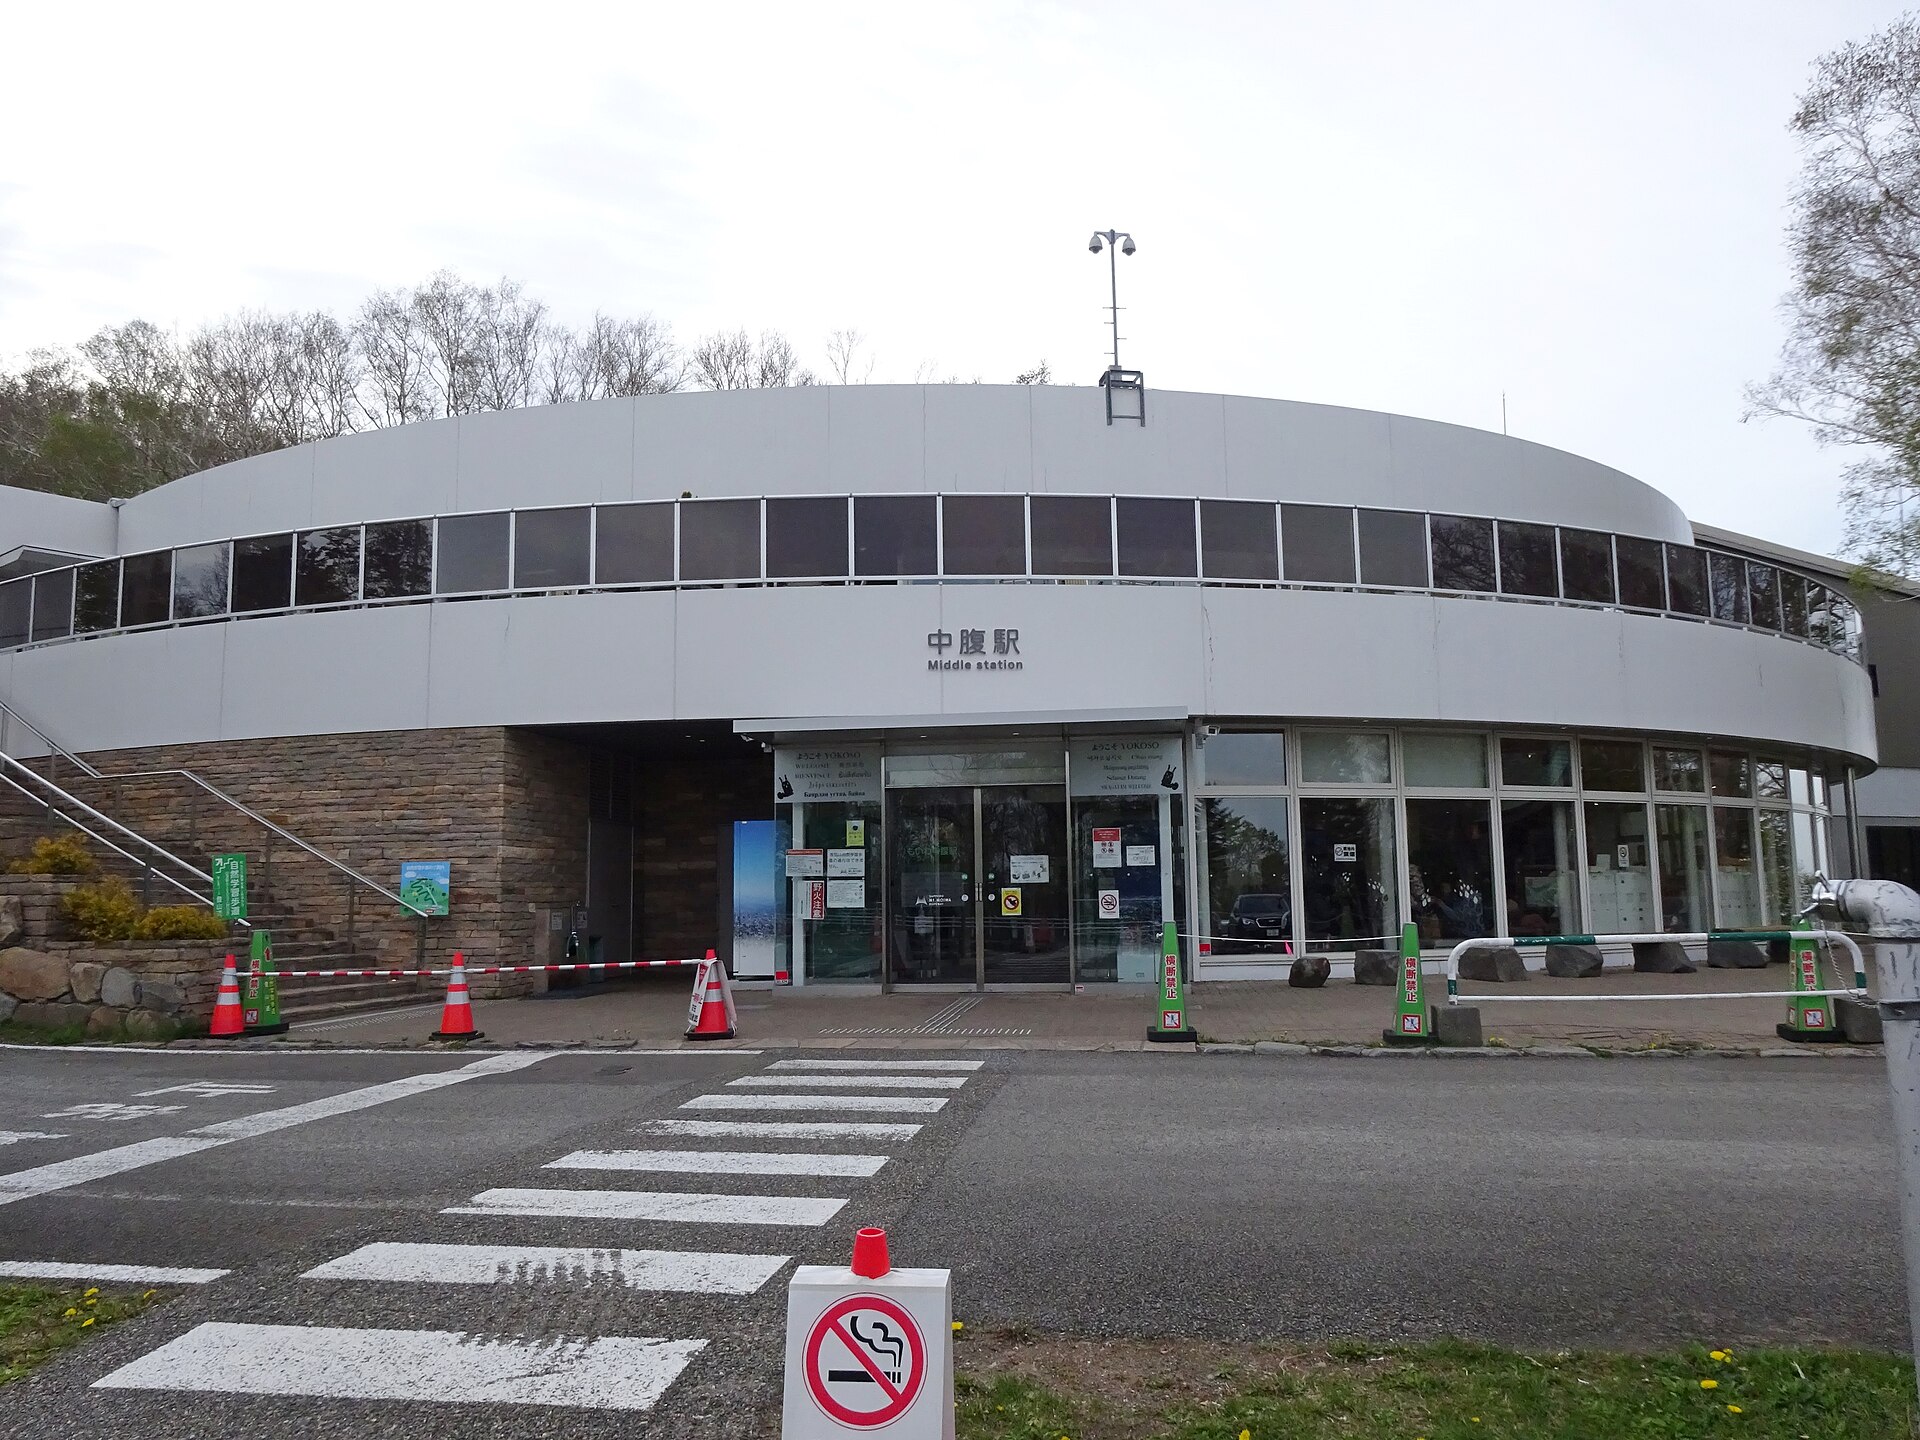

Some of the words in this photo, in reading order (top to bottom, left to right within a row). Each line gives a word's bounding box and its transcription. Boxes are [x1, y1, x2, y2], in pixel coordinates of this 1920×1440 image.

[927, 628, 1020, 655] 中腹駅
[927, 660, 972, 671] Middle
[976, 660, 1023, 671] station
[825, 752, 861, 760] YOKOSO
[1120, 741, 1160, 750] YOKOSO
[812, 882, 822, 918] 野火注意
[1165, 954, 1177, 999] 横断禁止
[1405, 957, 1417, 1003] 横断禁止
